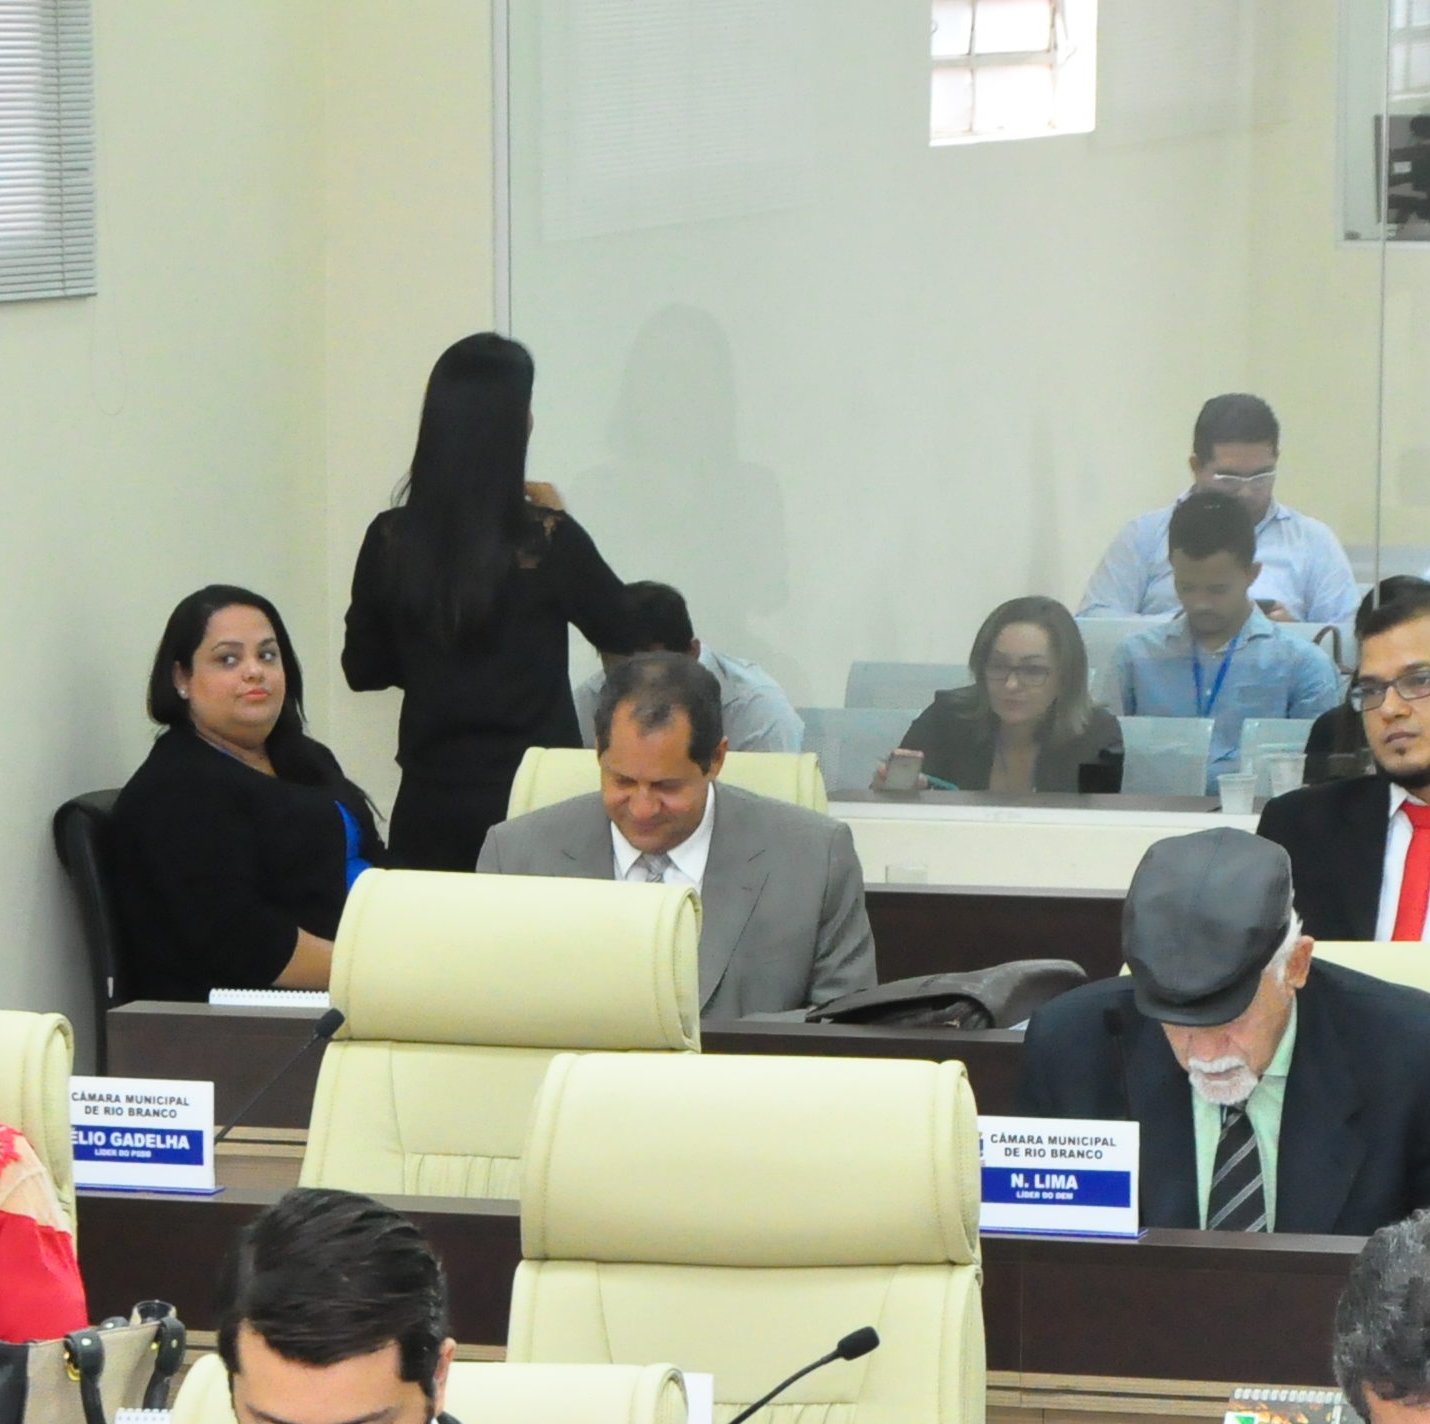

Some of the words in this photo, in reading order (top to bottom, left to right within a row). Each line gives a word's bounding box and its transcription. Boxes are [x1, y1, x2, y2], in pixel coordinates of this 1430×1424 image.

[71, 1090, 122, 1104] CÂMARA
[125, 1094, 190, 1106] MUNICIPAL
[84, 1105, 99, 1115] DE
[103, 1106, 124, 1117] RIO
[128, 1107, 178, 1119] BRANCO
[71, 1127, 106, 1146] ÉLIO
[110, 1132, 190, 1150] GADELHA
[990, 1132, 1044, 1145] CÂMARA
[1048, 1135, 1117, 1147] MUNICIPAL
[1004, 1147, 1021, 1157] DE
[1025, 1148, 1047, 1158] RIO
[1051, 1149, 1103, 1160] BRANCO
[1011, 1172, 1029, 1189] N.
[1034, 1173, 1079, 1190] LIMA
